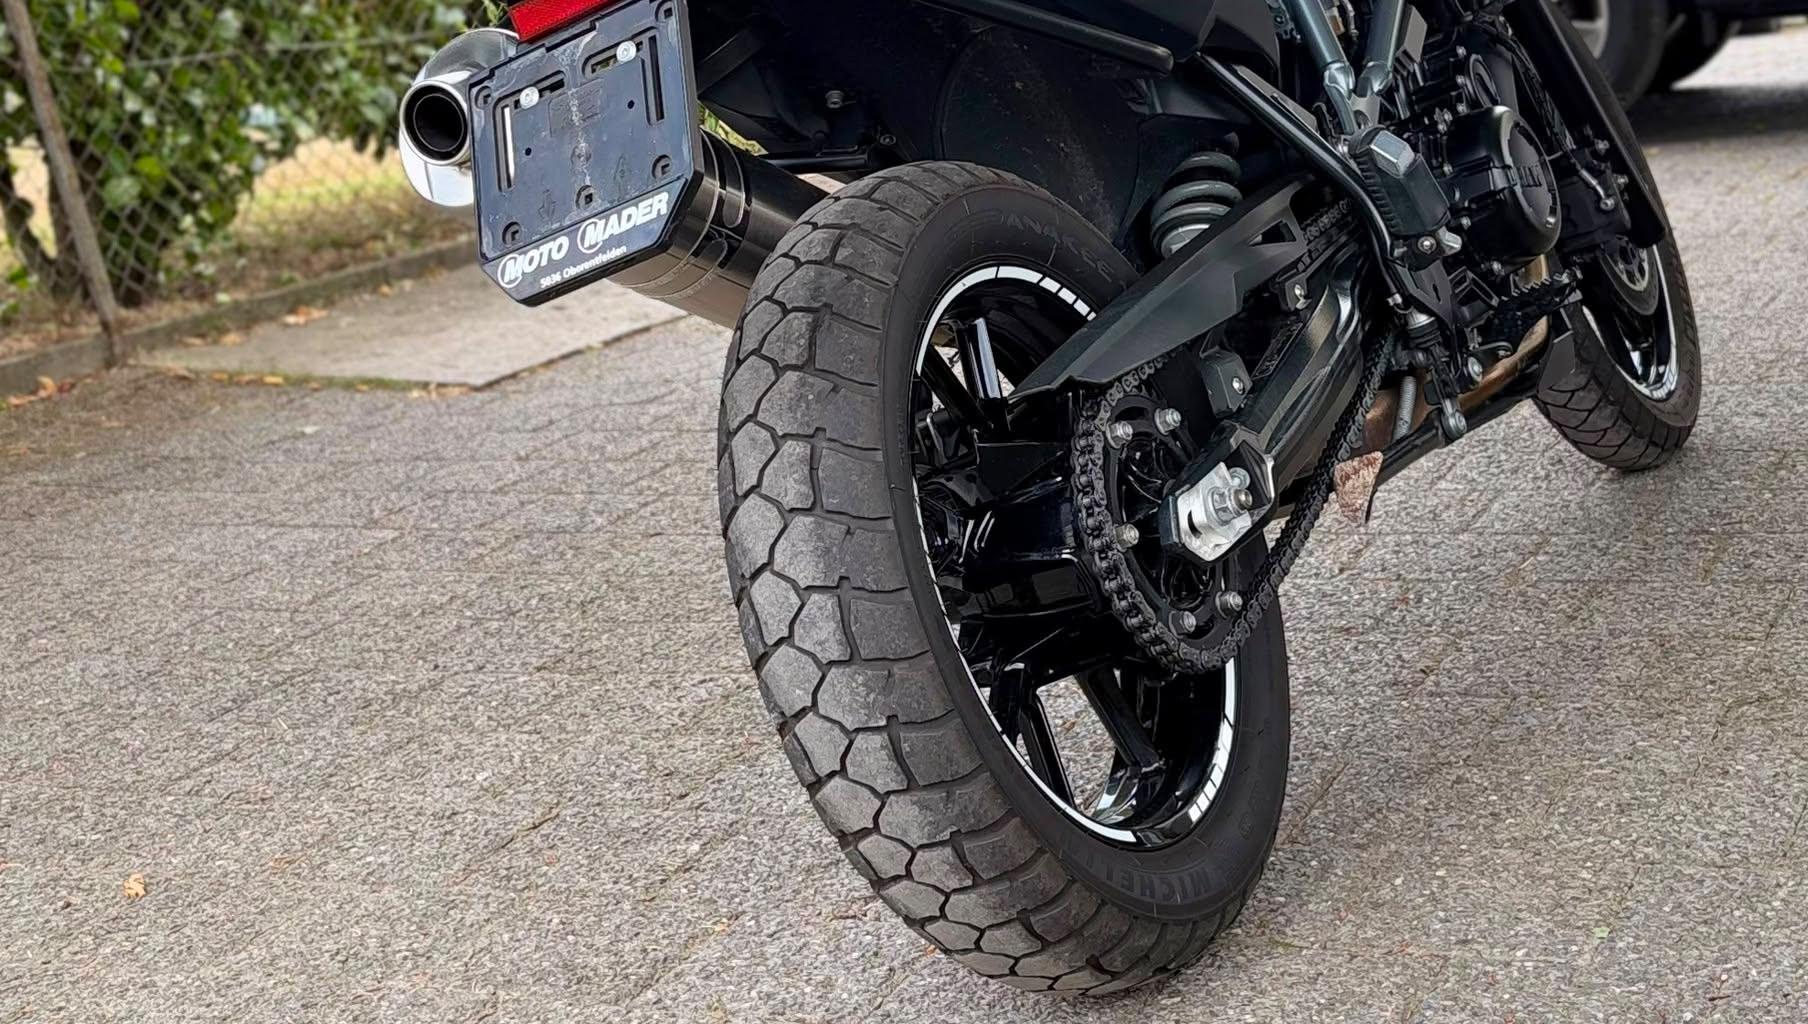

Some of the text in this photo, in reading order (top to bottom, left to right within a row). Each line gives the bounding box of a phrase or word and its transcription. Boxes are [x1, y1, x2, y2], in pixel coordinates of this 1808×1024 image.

[497, 191, 669, 288] MOTO MADER
[563, 245, 627, 278] Oberentfelden
